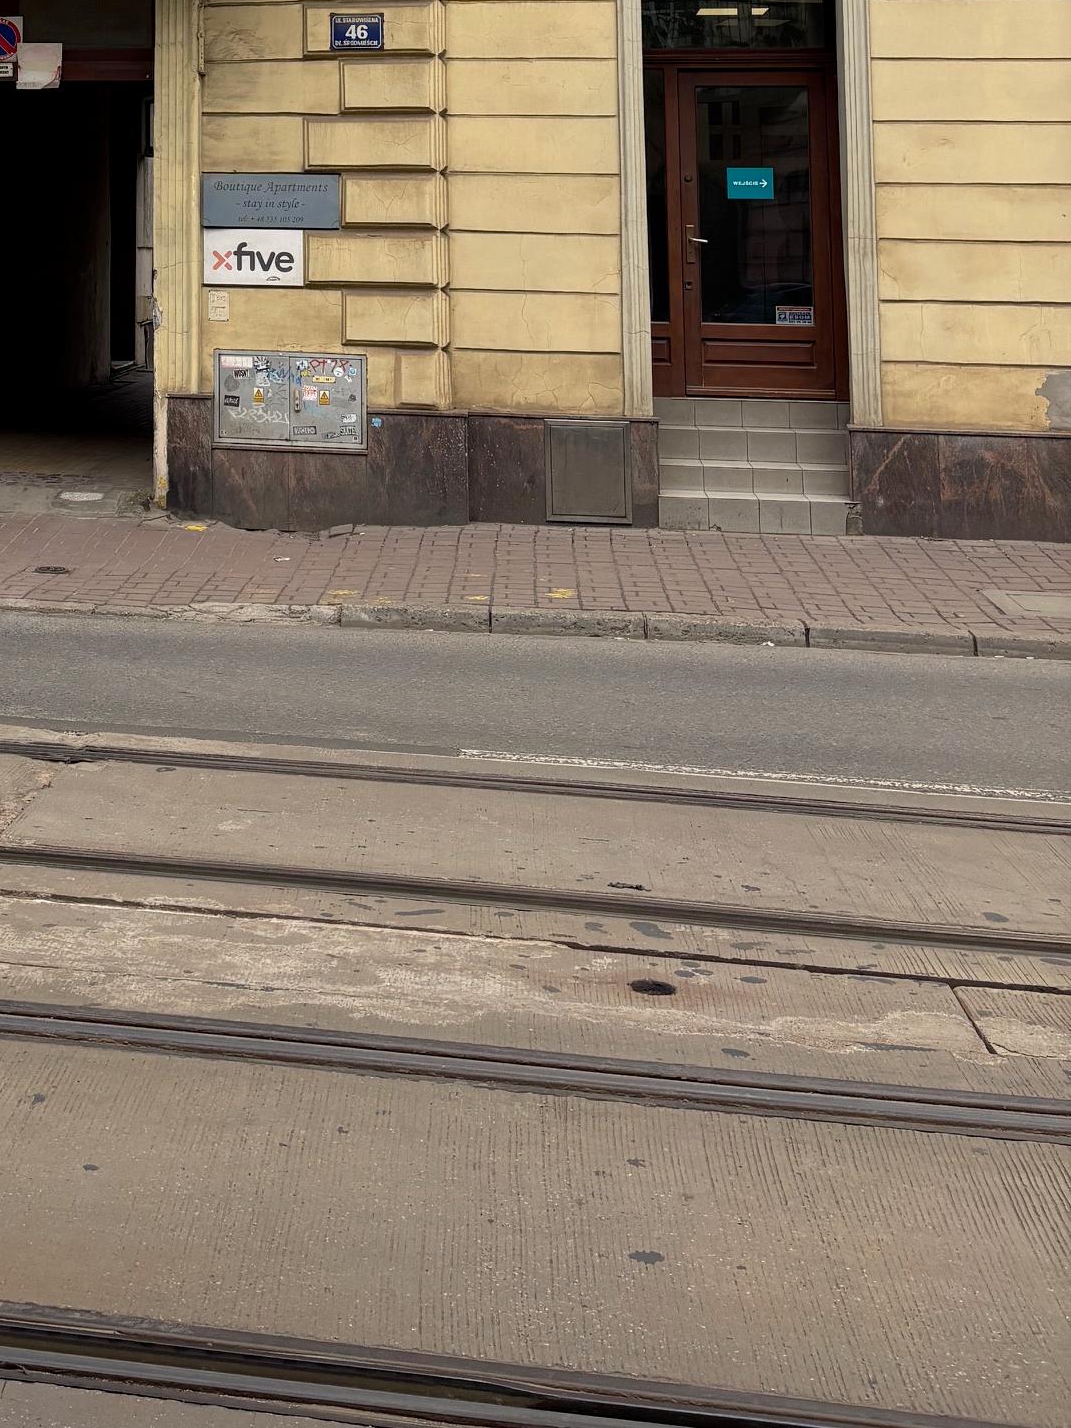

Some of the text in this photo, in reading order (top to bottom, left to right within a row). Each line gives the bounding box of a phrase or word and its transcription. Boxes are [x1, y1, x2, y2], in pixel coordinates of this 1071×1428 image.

[345, 24, 369, 40] 46
[214, 180, 329, 195] Boutique Apartments
[242, 199, 263, 211] stay
[265, 199, 275, 208] in
[276, 198, 300, 211] style
[212, 241, 295, 272] xfive
